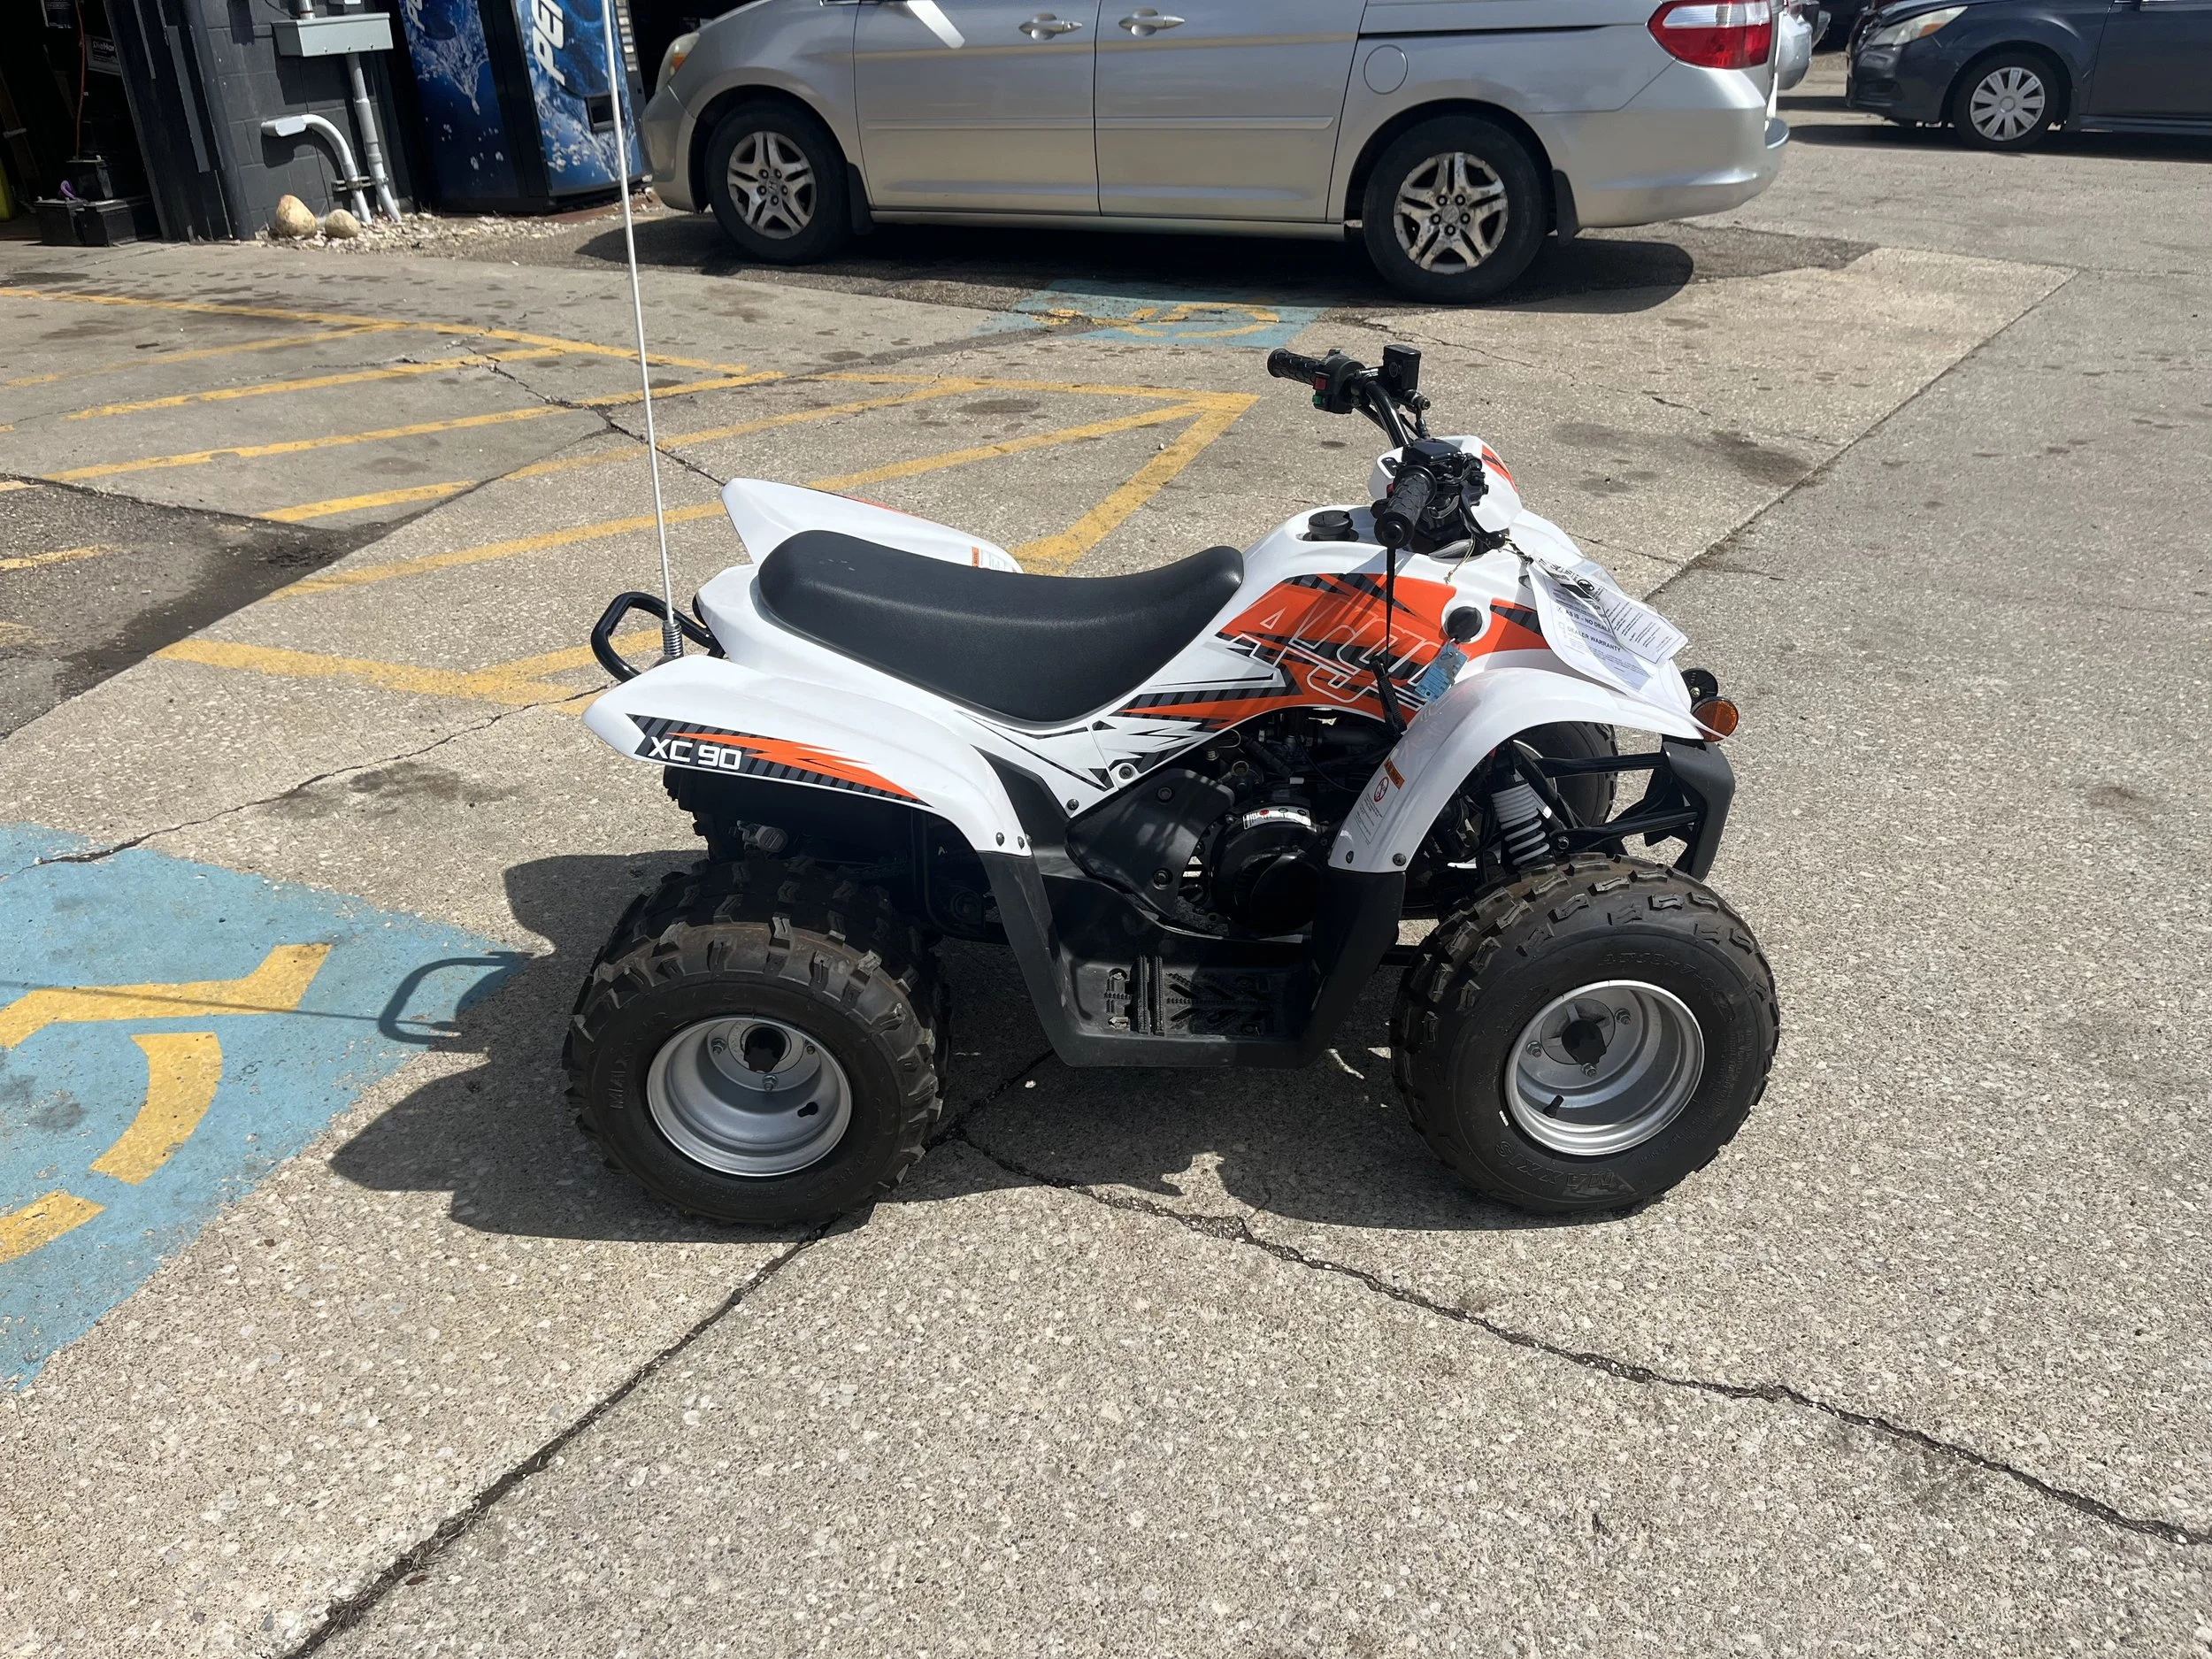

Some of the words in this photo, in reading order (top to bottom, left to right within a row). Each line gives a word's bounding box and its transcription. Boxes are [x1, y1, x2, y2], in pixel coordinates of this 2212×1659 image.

[1567, 626, 1589, 639] DEALER
[1591, 636, 1621, 652] WARRANTY
[648, 736, 693, 763] XC
[697, 744, 742, 771] 90
[1495, 1141, 1615, 1190] MAXXIS
